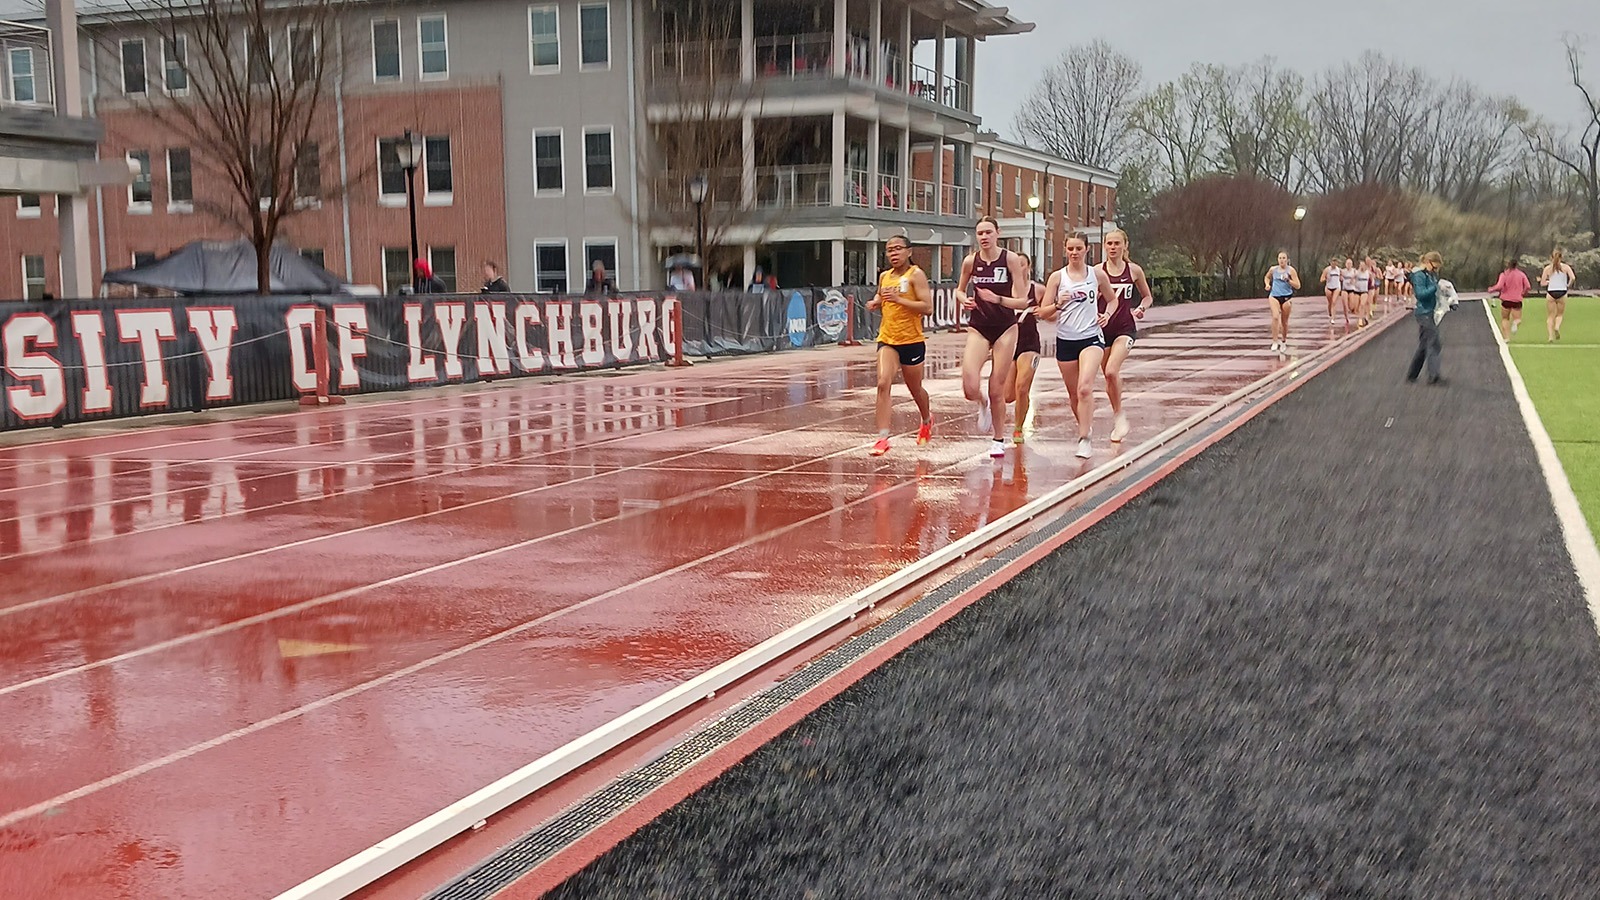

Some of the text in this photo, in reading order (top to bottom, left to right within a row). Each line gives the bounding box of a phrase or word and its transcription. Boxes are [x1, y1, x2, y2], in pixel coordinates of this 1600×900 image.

[997, 268, 1005, 281] 7
[1088, 290, 1095, 304] 9
[1126, 284, 1133, 298] 6
[2, 297, 677, 420] SITY OF LYNCHBURG
